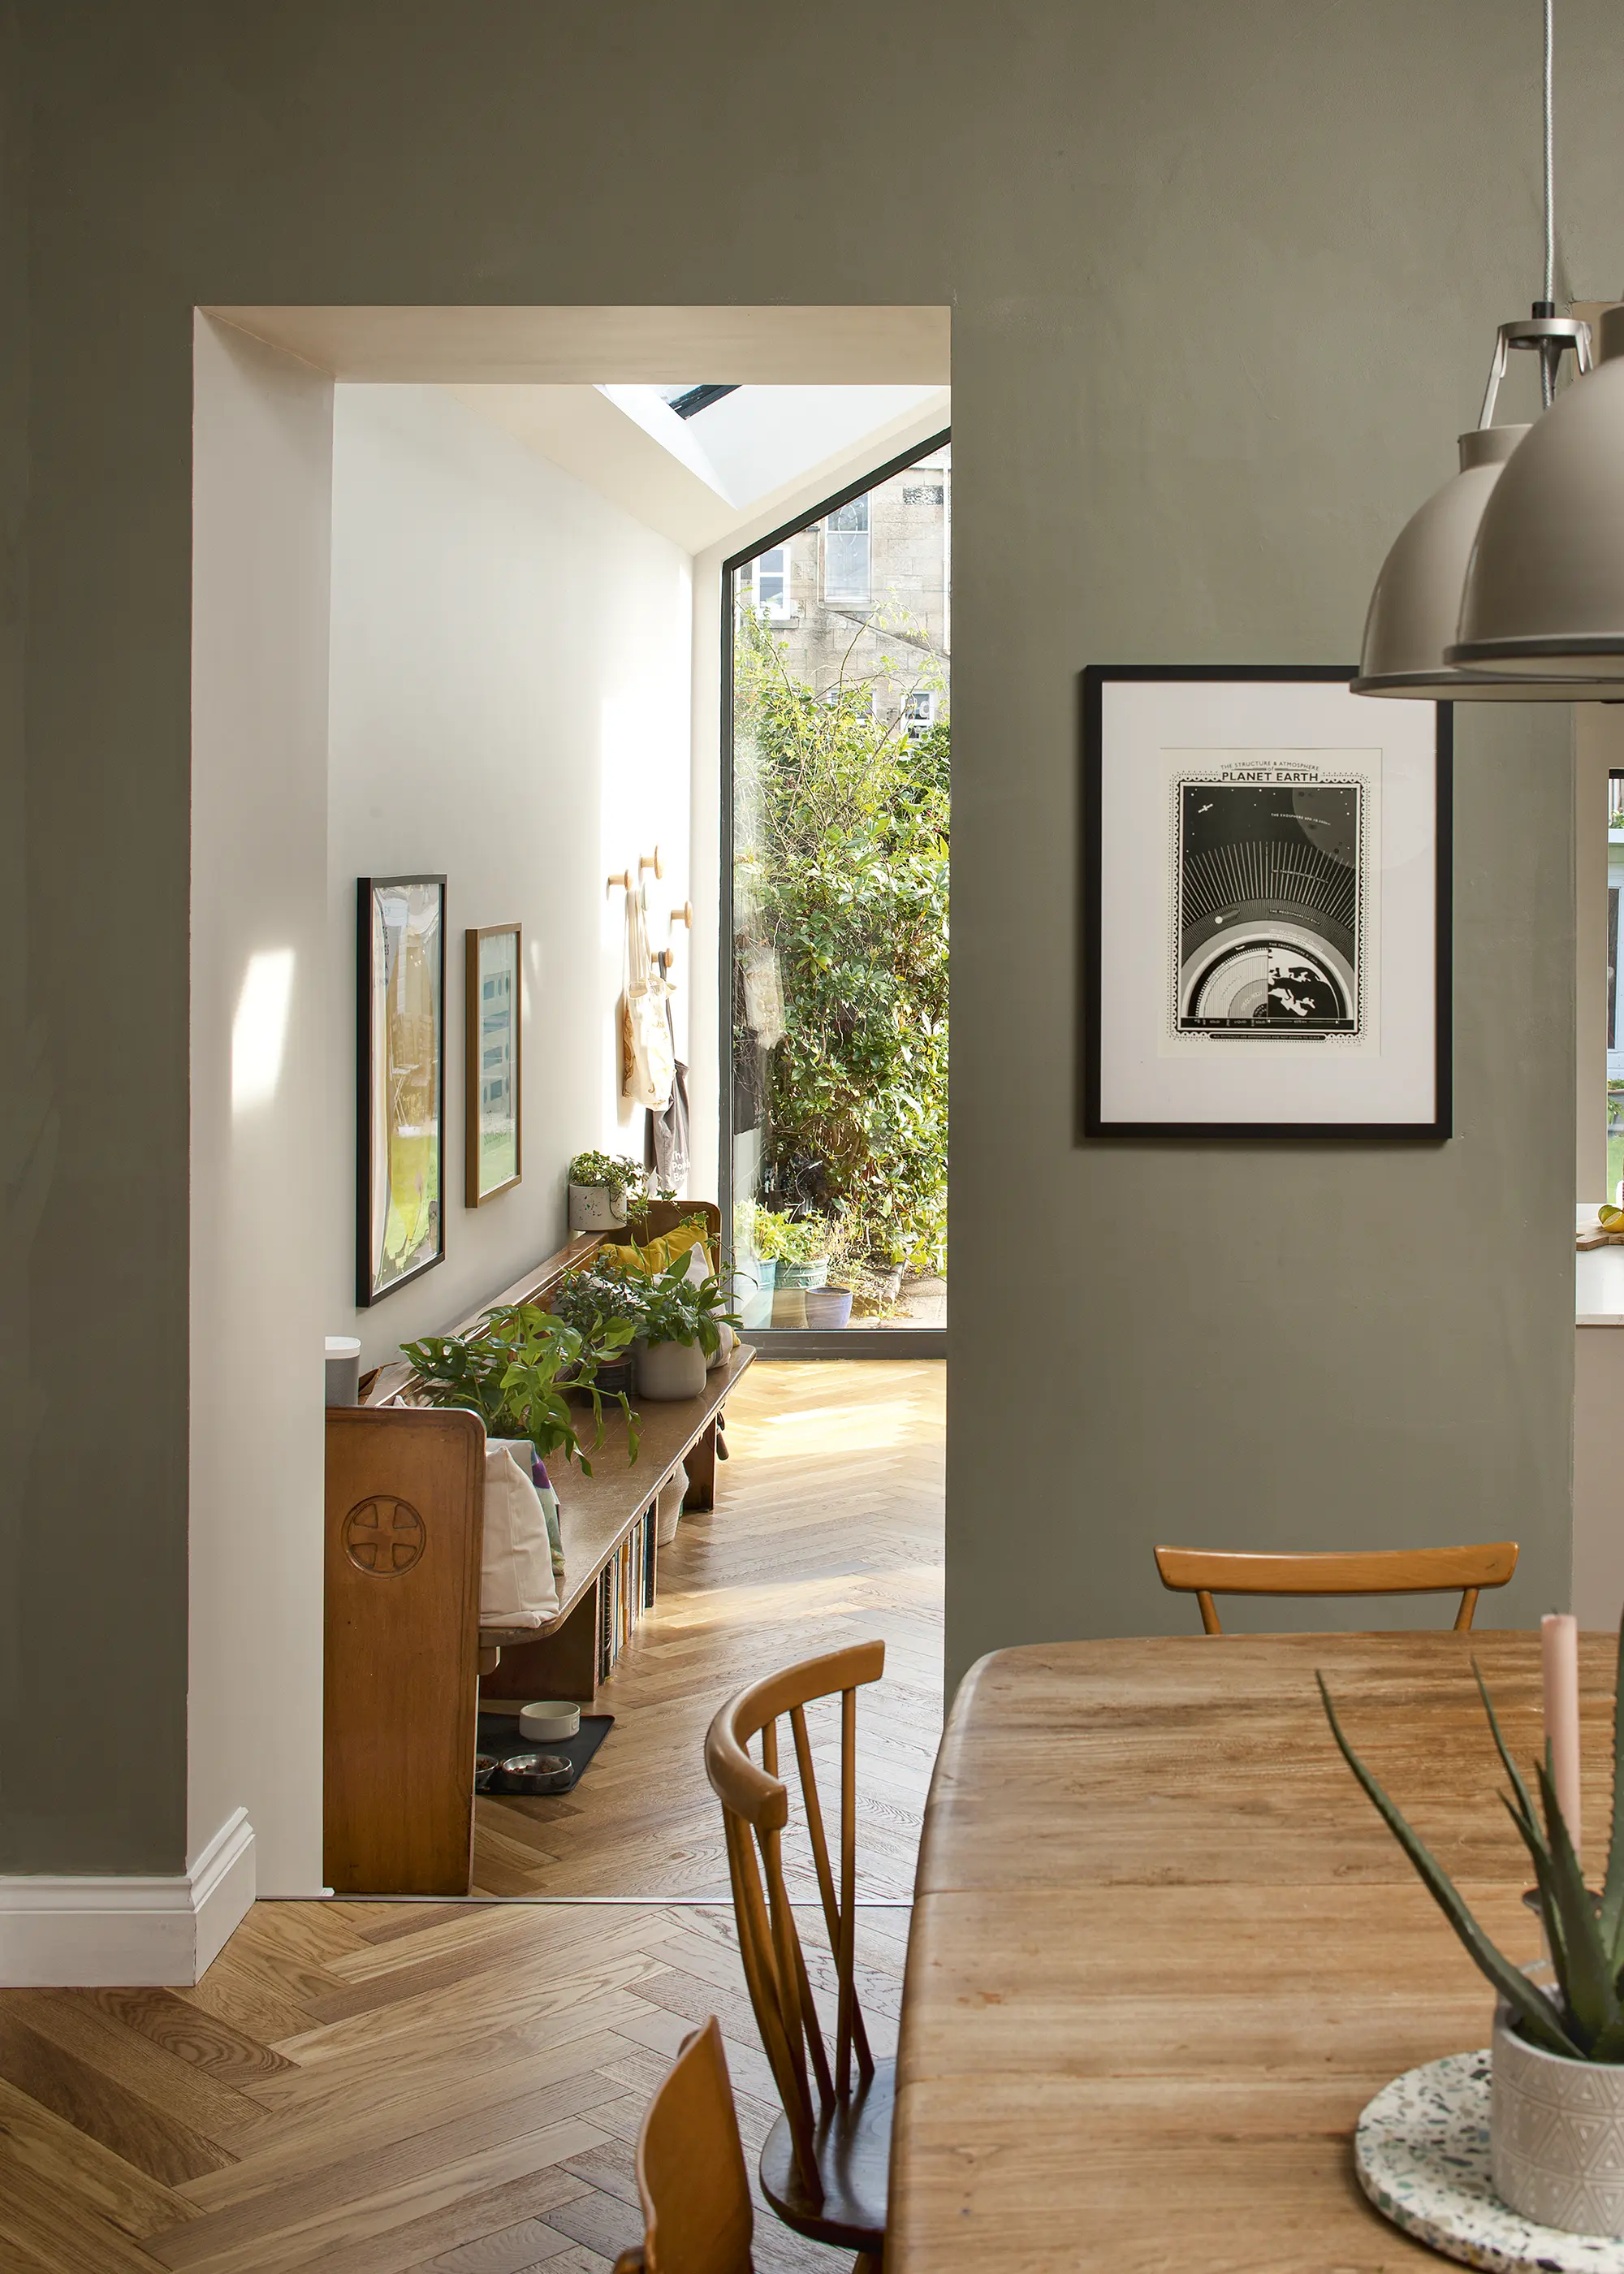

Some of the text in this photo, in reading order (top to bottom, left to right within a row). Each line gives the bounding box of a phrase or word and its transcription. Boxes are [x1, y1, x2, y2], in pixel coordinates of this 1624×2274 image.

[1279, 761, 1320, 771] ATMOSPHERE
[1222, 772, 1319, 781] PLANET EARTH
